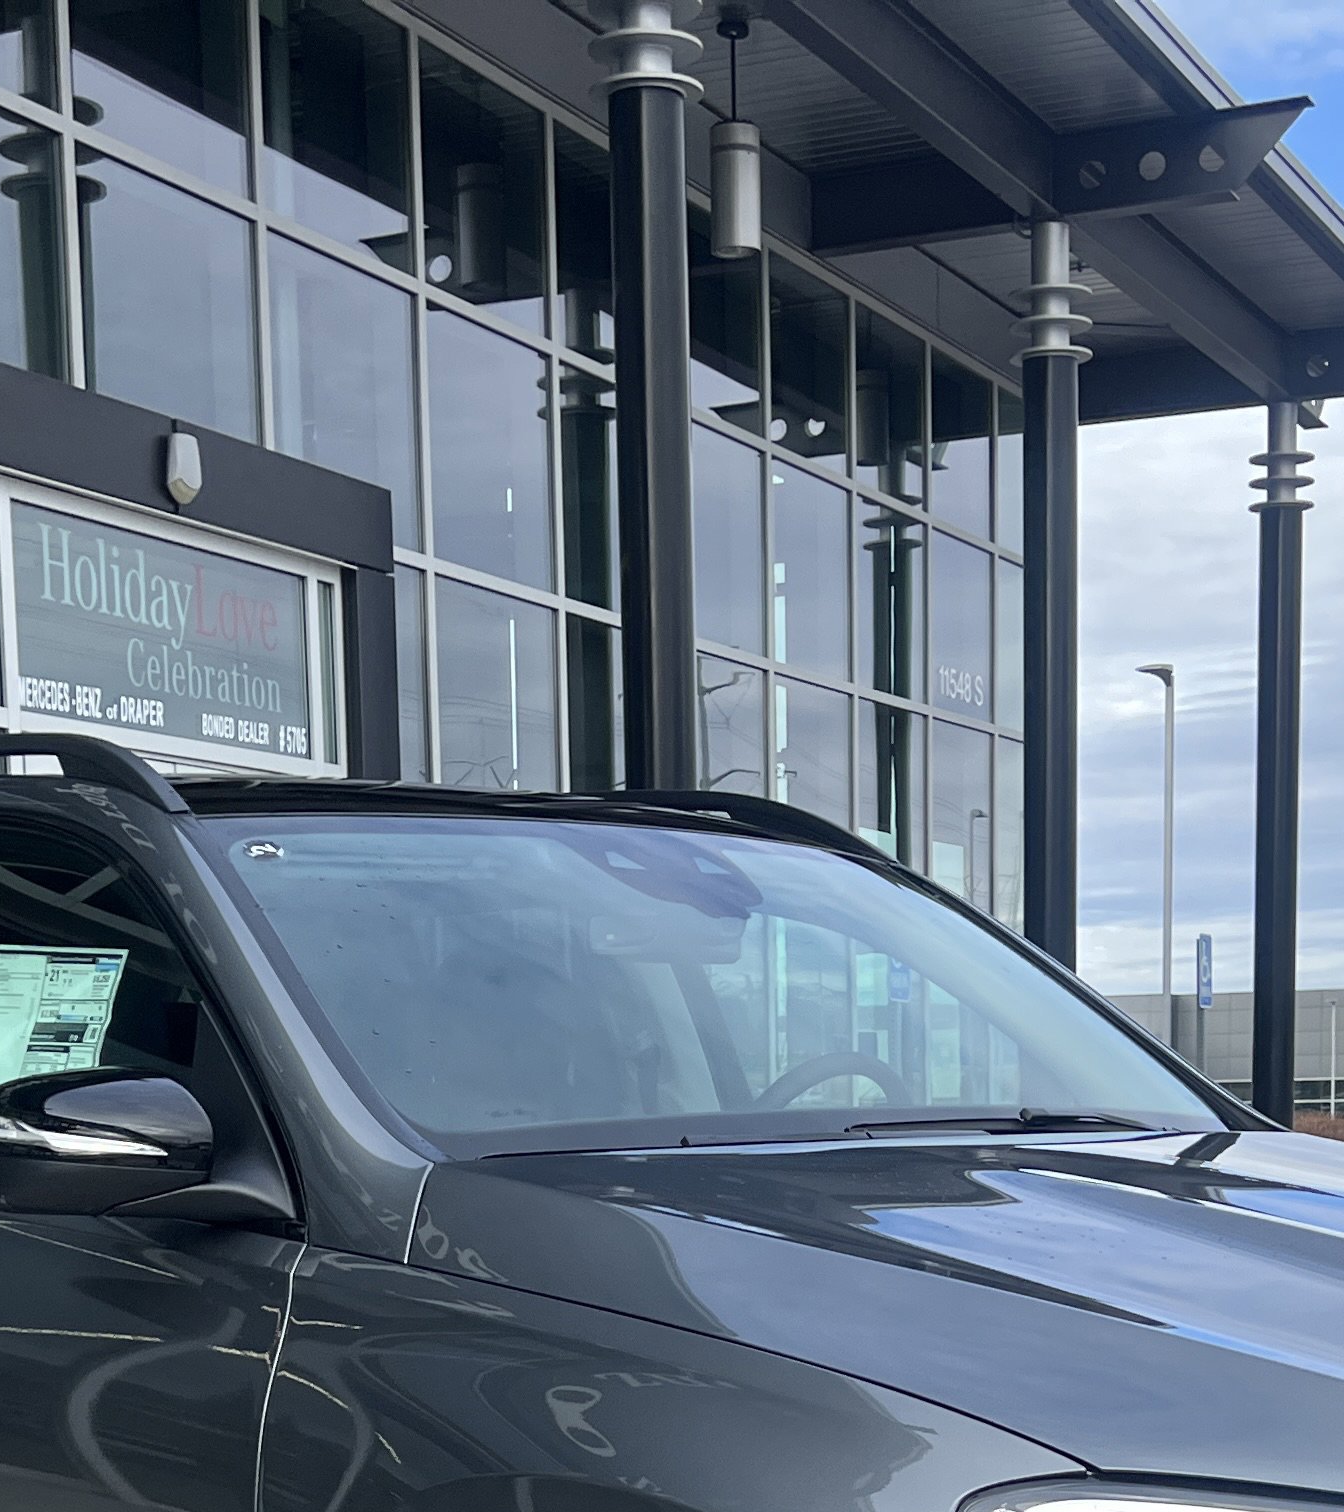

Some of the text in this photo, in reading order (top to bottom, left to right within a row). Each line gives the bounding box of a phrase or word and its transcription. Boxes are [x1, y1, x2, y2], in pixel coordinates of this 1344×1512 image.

[38, 523, 278, 651] Holiday Love
[127, 637, 282, 713] Celebration
[939, 665, 984, 706] 11548 S
[106, 703, 118, 720] of
[120, 696, 164, 727] DRAPER
[202, 713, 235, 739] BONDED
[238, 720, 270, 745] DEALER
